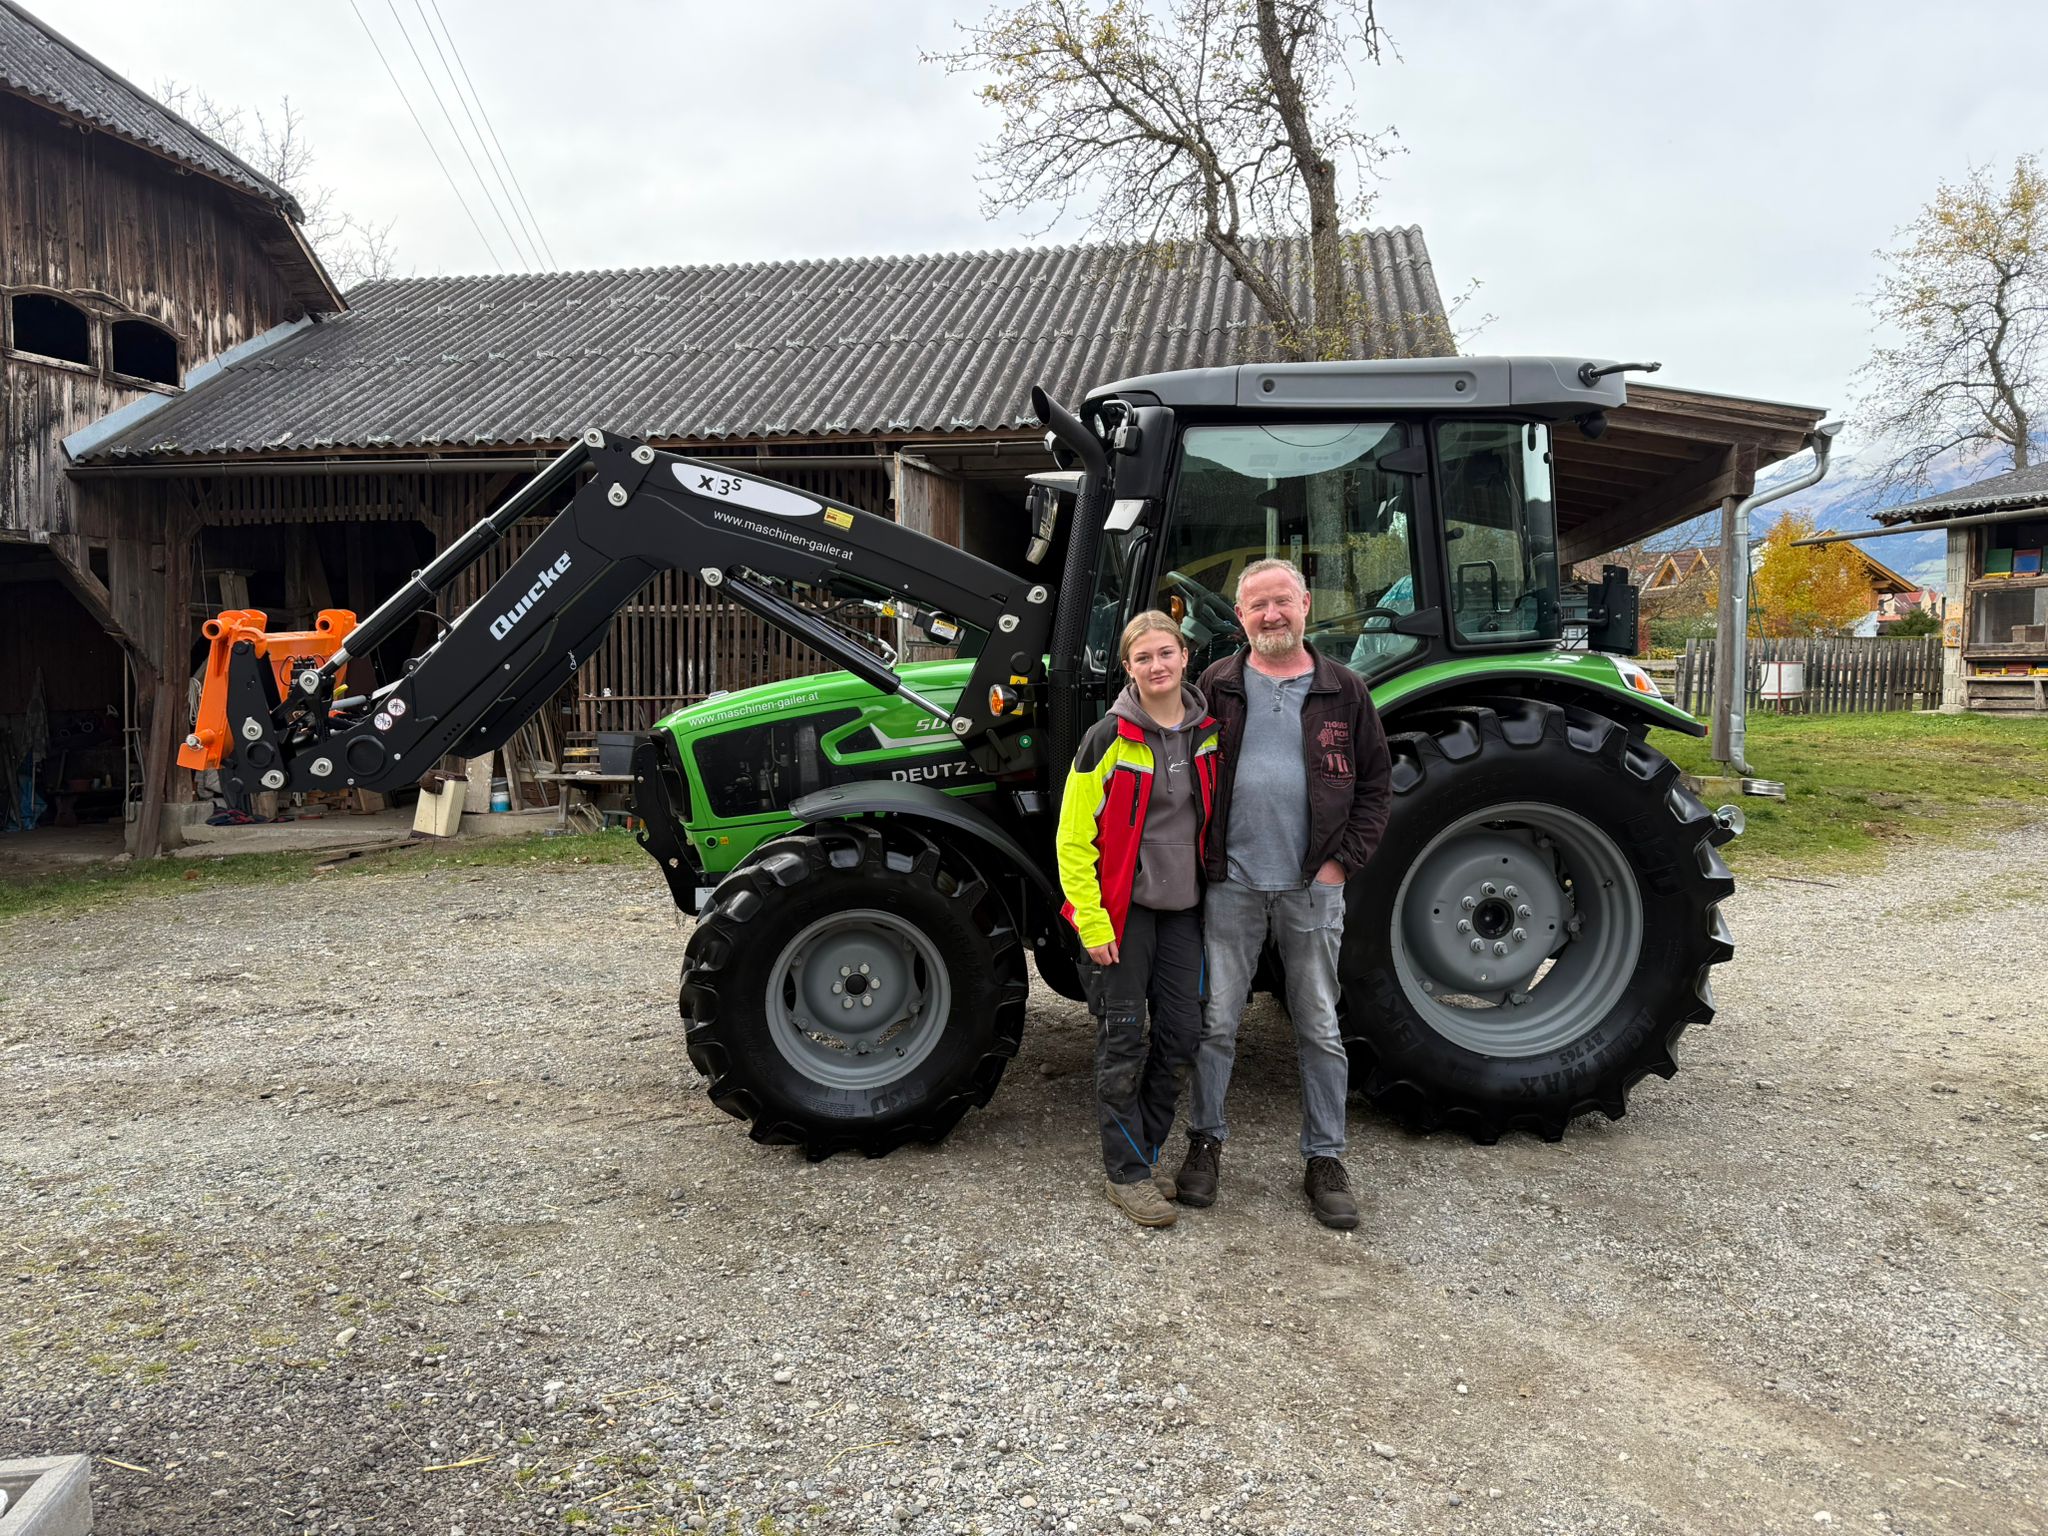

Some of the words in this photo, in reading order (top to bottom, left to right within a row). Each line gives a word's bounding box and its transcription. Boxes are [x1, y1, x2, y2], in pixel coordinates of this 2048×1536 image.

[713, 510, 854, 561] www.maschinen-gailer.at
[489, 551, 572, 640] Quicke
[688, 691, 820, 727] www.maschinen-gailer.at
